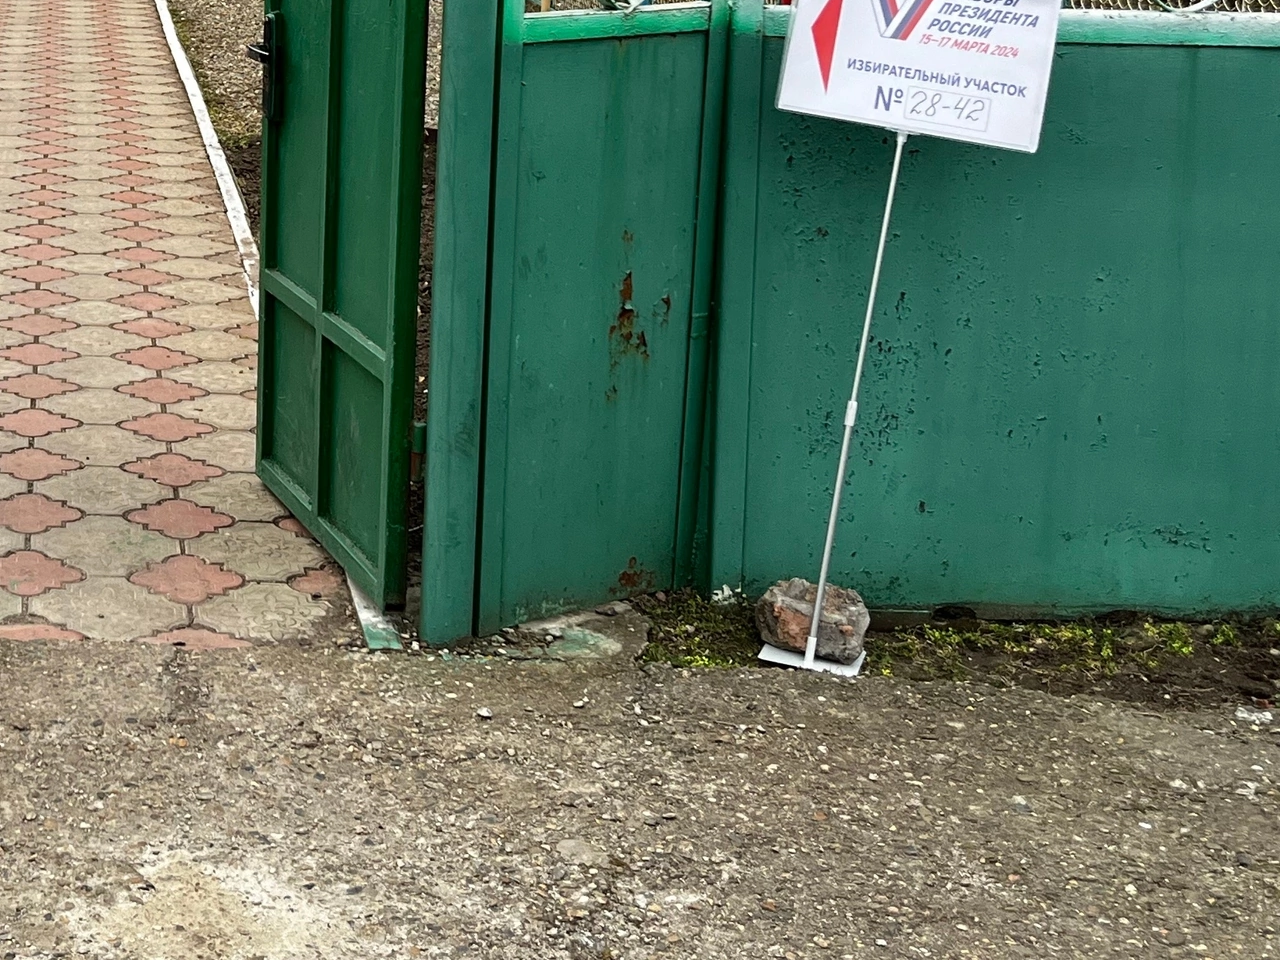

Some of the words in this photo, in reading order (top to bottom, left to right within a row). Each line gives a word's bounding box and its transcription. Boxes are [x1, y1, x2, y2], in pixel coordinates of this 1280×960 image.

[938, 2, 1040, 28] ПРЕЗИДЕНТА
[927, 18, 994, 39] РОССИИ
[950, 38, 990, 54] МАРТА
[990, 44, 1020, 58] 2024
[847, 58, 961, 88] ИЗБИРАТЕЛЬНЫЙ
[964, 78, 1028, 98] УЧАСТОК
[874, 86, 904, 111] №
[908, 90, 986, 122] 28-42
